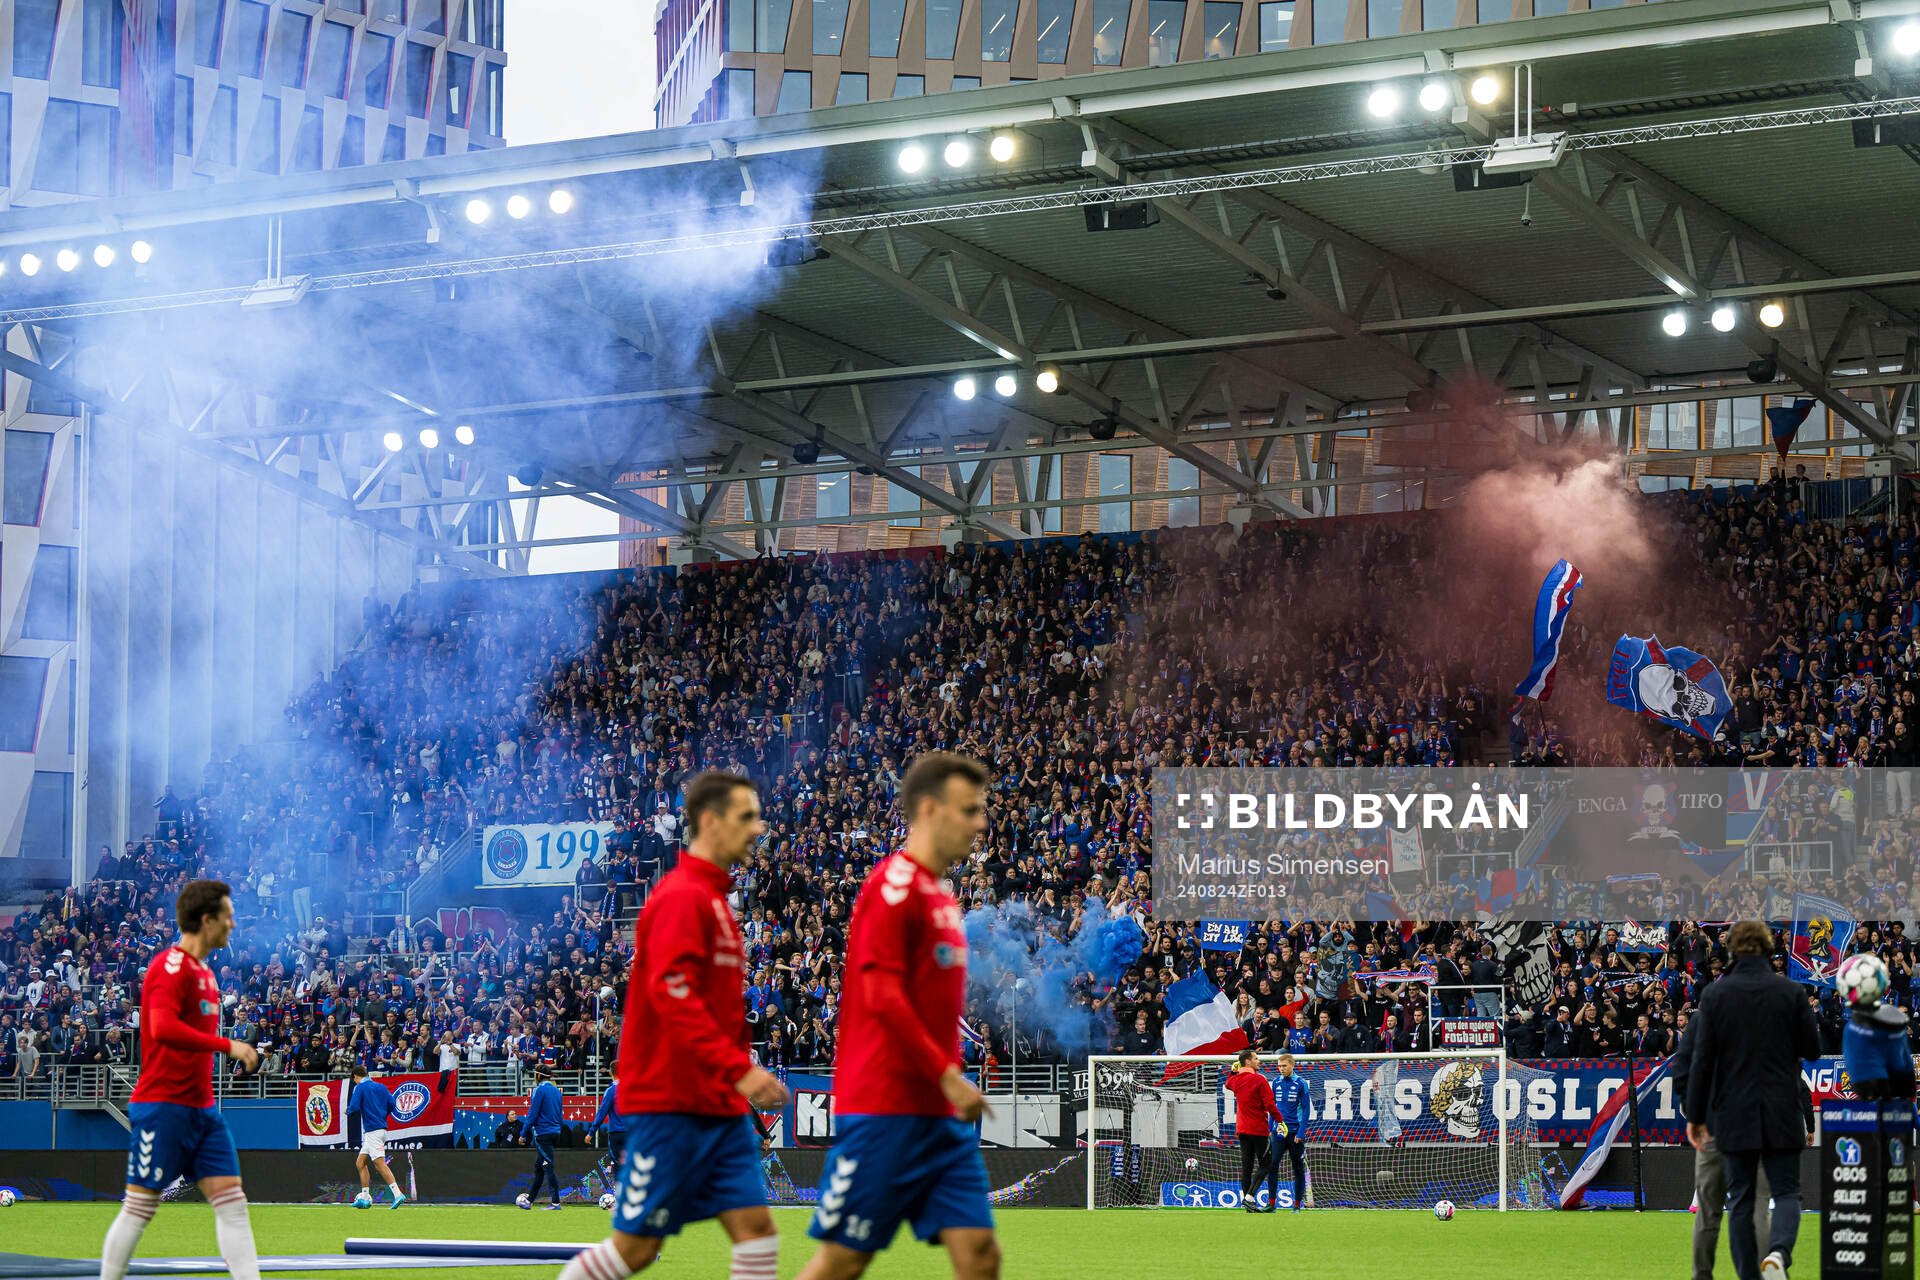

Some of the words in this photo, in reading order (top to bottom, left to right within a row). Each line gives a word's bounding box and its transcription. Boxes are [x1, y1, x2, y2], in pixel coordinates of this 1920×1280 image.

[1577, 796, 1628, 814] ENGA
[1678, 793, 1723, 809] TIFO
[535, 829, 614, 870] 199
[1833, 1166, 1867, 1182] OBOS
[1833, 1189, 1867, 1205] SELECT
[1835, 1250, 1866, 1266] coop
